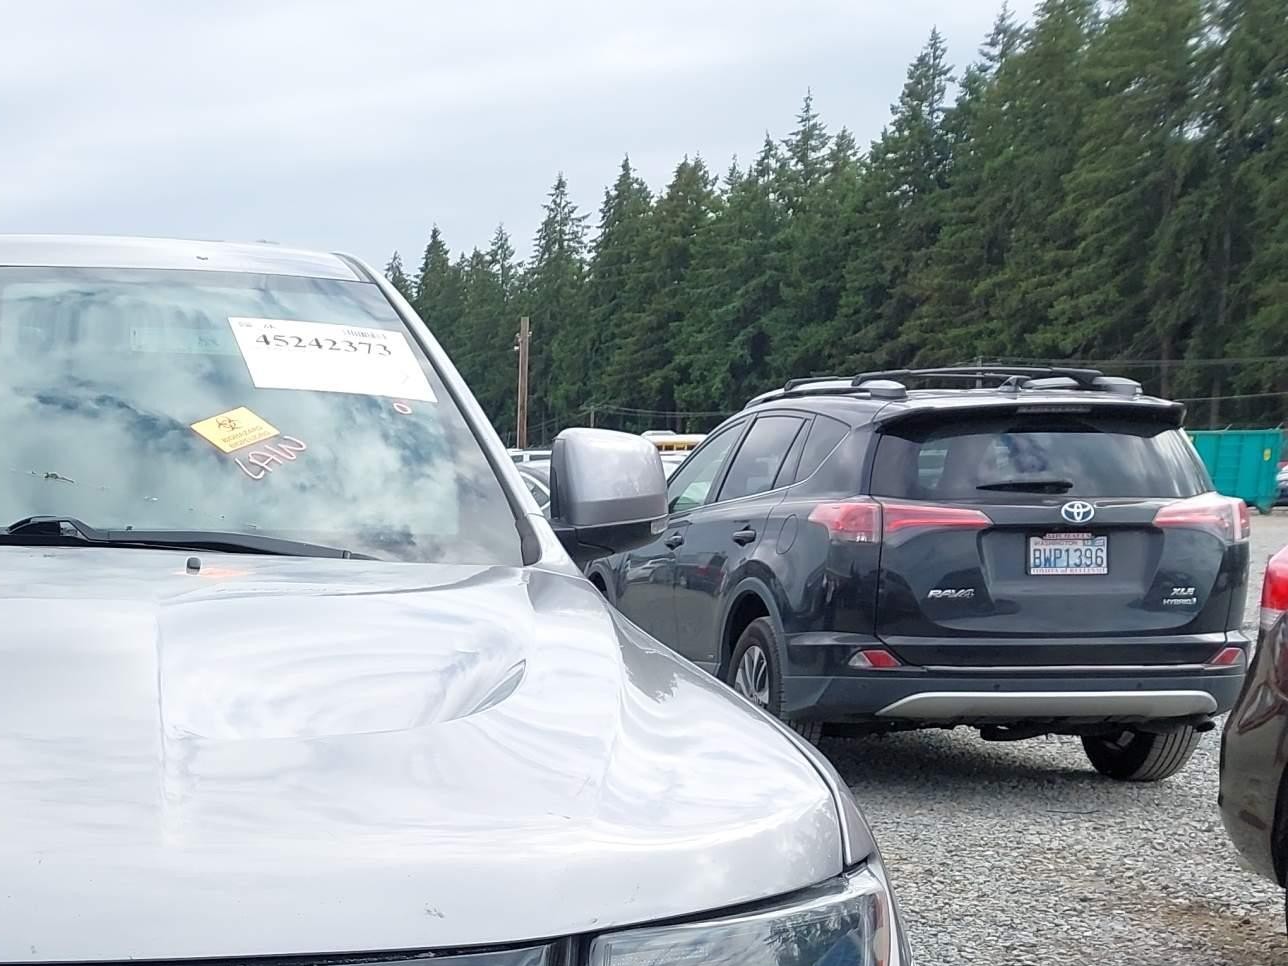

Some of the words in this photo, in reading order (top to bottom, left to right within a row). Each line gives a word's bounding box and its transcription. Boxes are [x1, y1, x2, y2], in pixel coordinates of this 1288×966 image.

[255, 333, 393, 357] 45242373
[1033, 548, 1104, 568] BWP1396
[927, 588, 975, 599] RAV4
[1171, 587, 1195, 596] XLE
